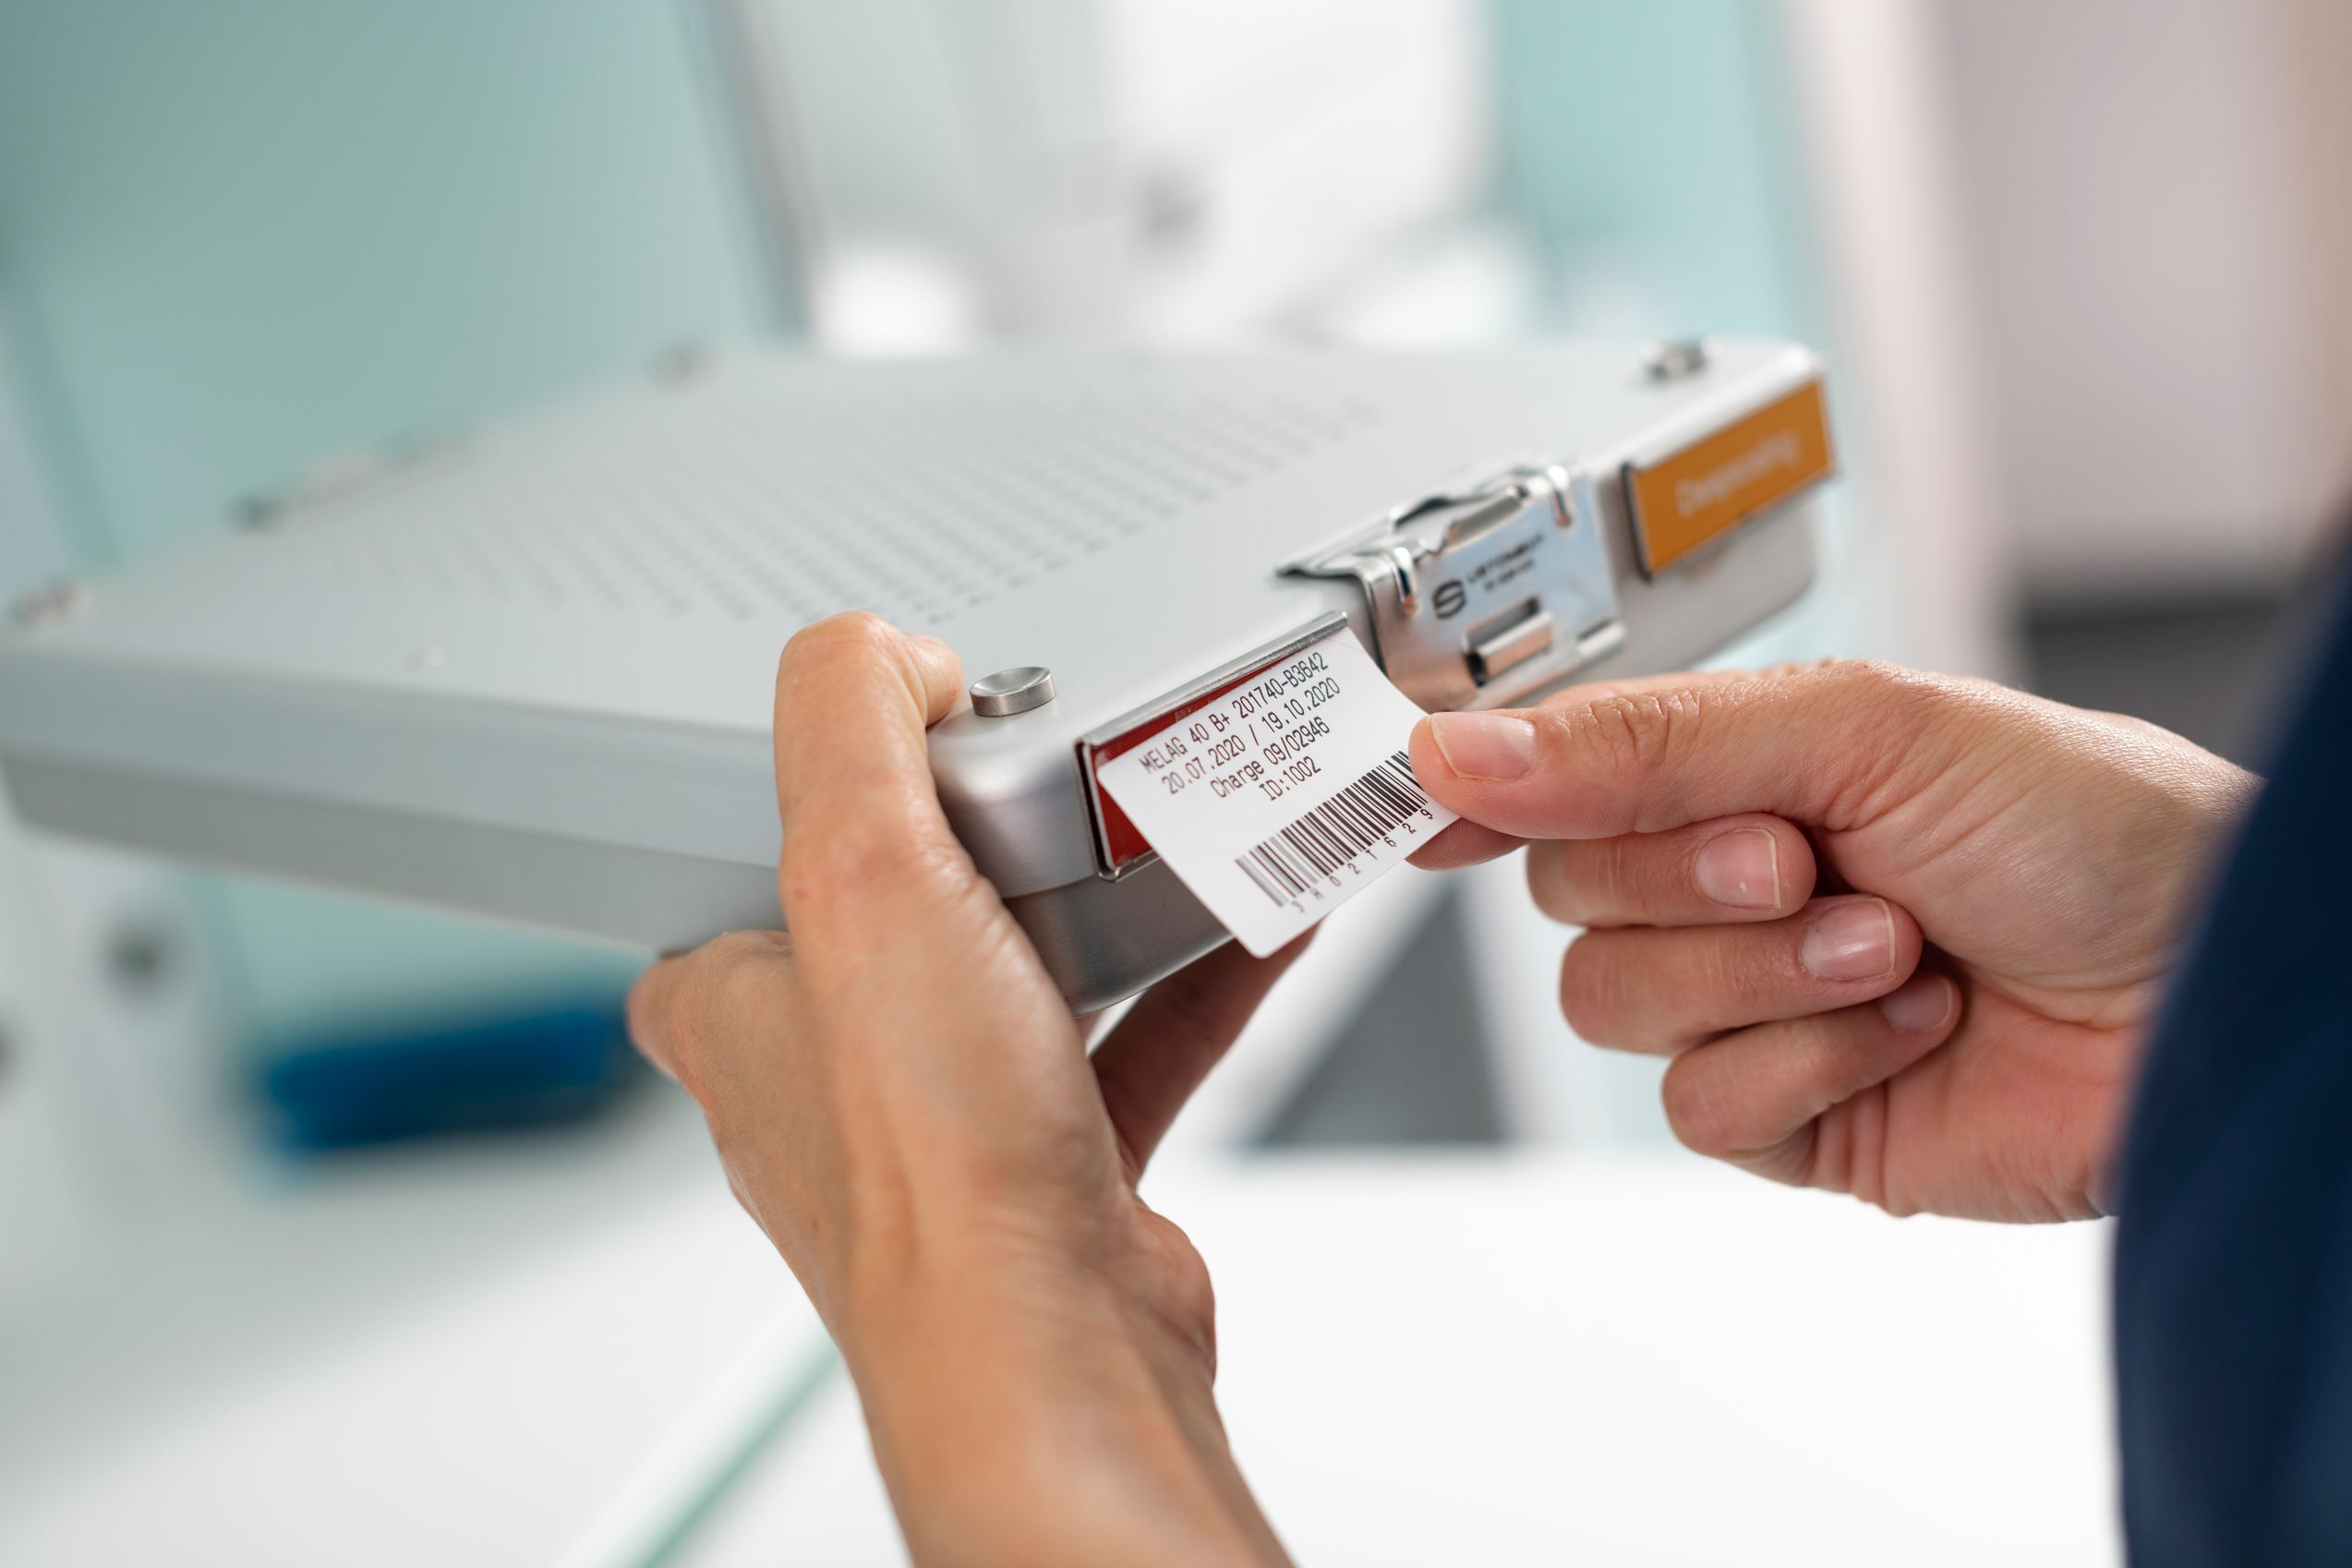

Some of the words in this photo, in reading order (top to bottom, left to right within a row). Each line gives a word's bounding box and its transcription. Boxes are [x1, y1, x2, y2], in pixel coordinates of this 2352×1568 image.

[1138, 737, 1188, 774] MELAG
[1188, 723, 1210, 744] 40
[1209, 713, 1230, 733] B+
[1232, 651, 1329, 719] 201740-B3642
[1161, 734, 1247, 795] 20.07.2020
[1248, 724, 1260, 747] /
[1261, 677, 1341, 733] 19.10.2020
[1210, 760, 1265, 798] Charge
[1263, 716, 1330, 766] 09/02946
[1259, 755, 1321, 802] ID:1002
